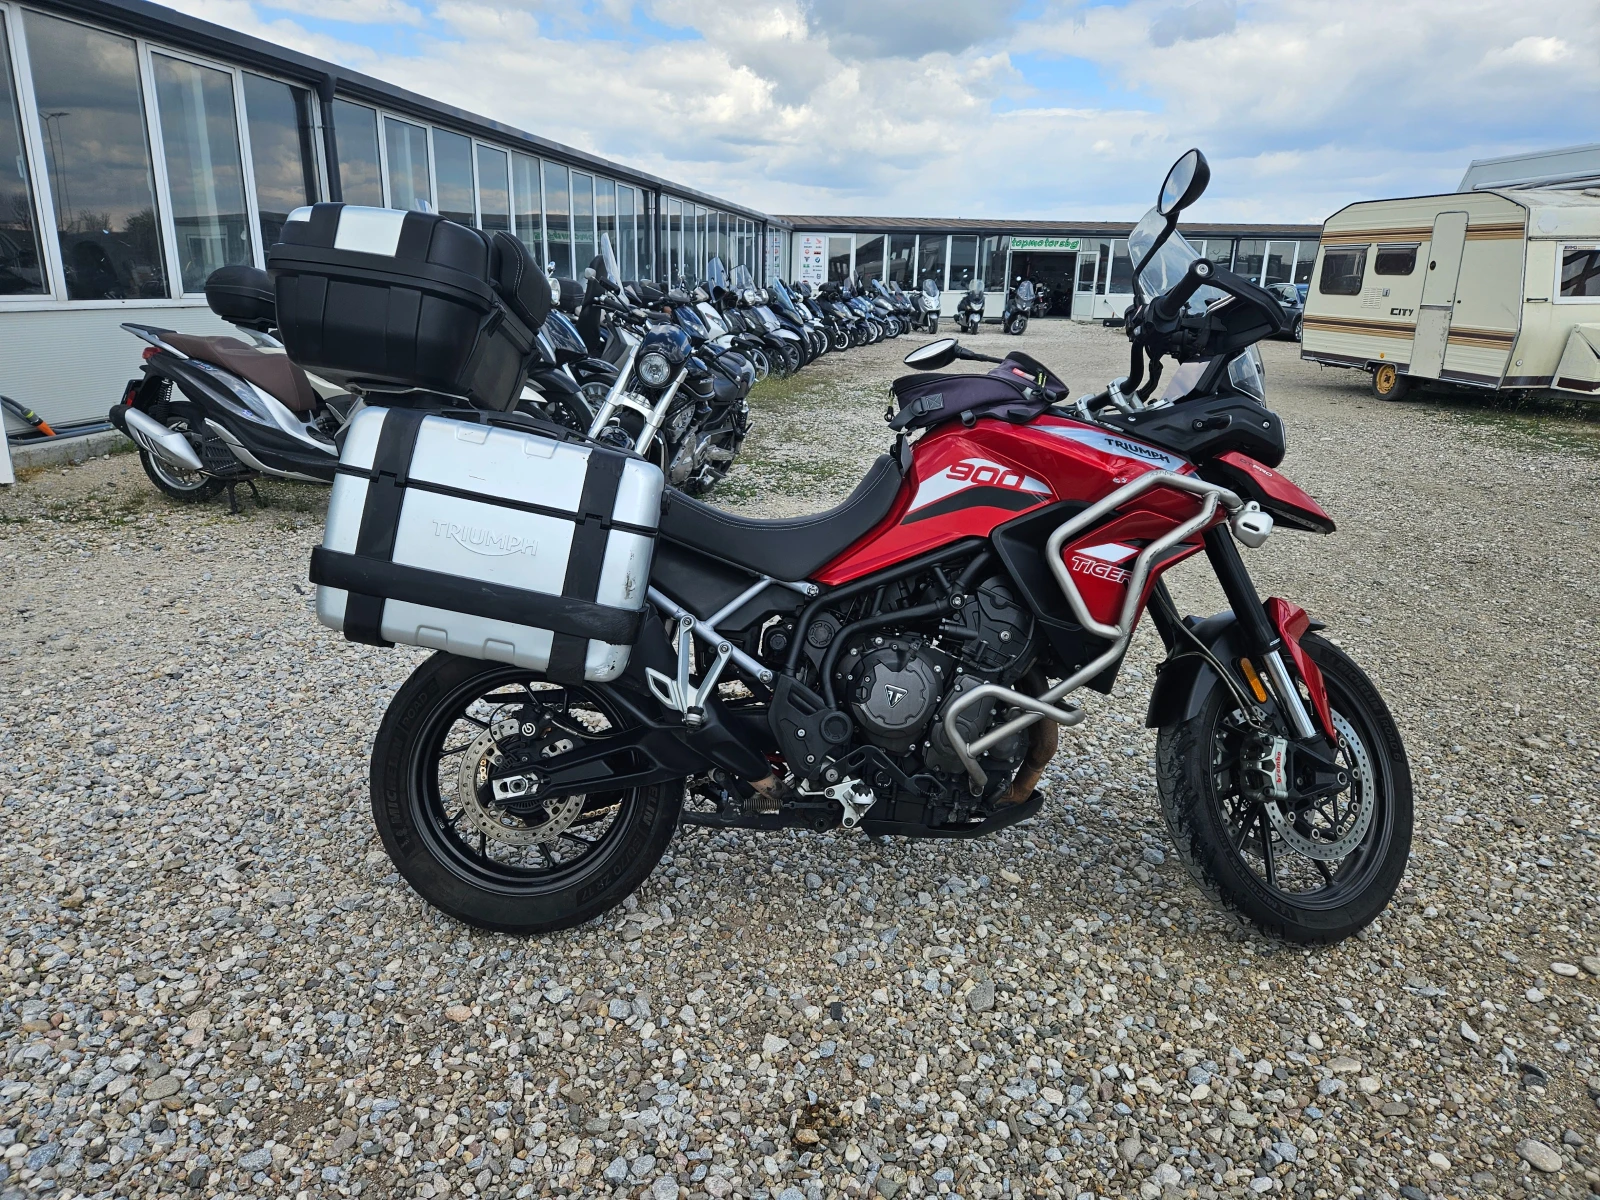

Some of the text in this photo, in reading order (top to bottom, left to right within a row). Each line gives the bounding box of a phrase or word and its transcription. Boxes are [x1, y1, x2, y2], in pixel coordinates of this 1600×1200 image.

[1011, 237, 1079, 250] topmotorsbg
[1390, 308, 1414, 316] CITY
[1104, 438, 1170, 463] TRIUMPH
[946, 463, 1025, 489] 900
[433, 519, 538, 556] TRIUMPH
[1336, 661, 1381, 715] MICHELIN
[1382, 719, 1398, 750] ROAD
[386, 736, 404, 824] MICHELIN
[402, 692, 428, 727] ROAD
[642, 785, 658, 827] ELIN
